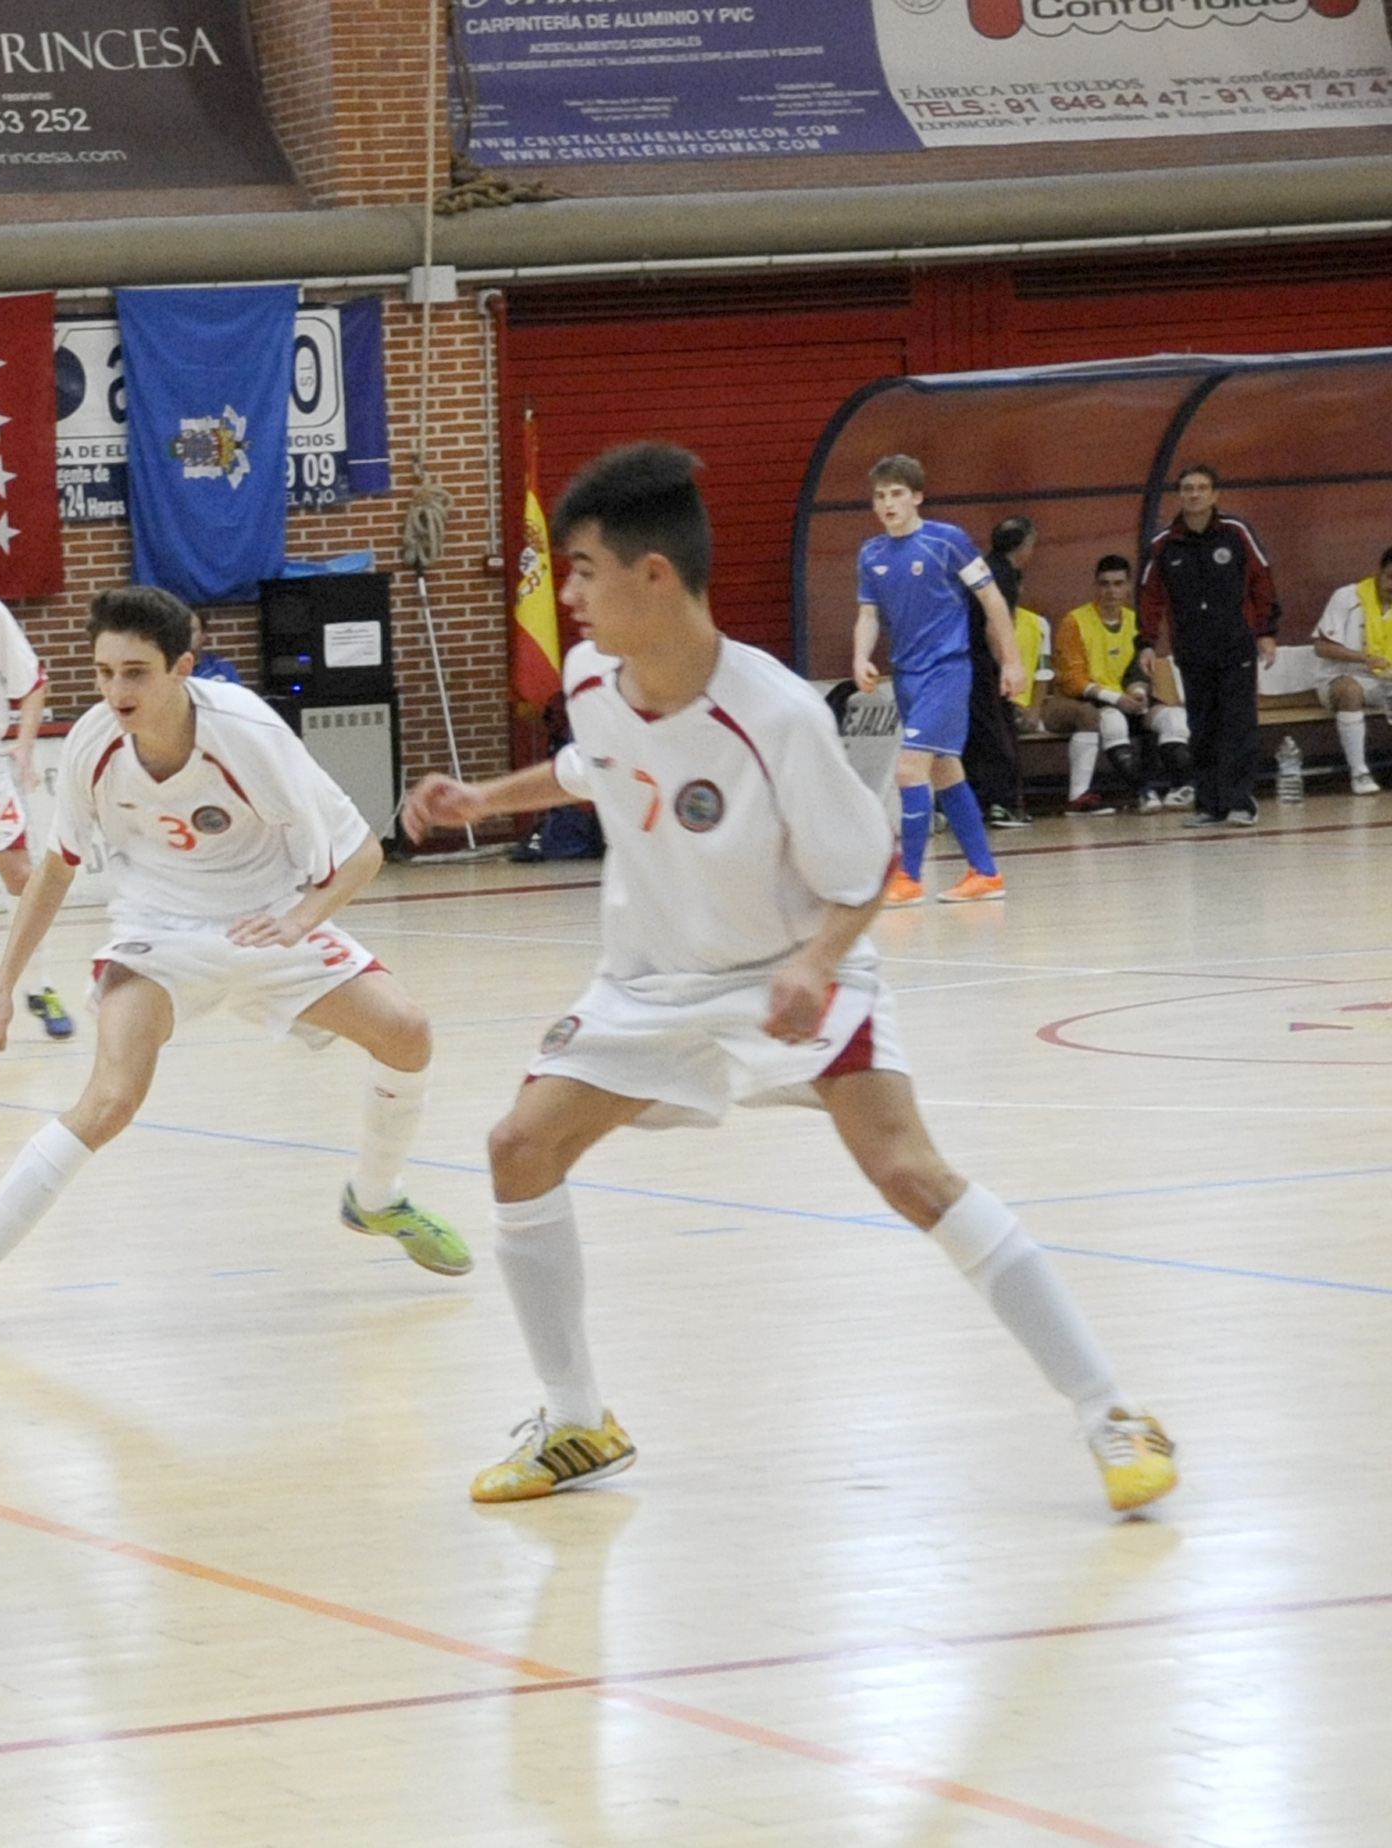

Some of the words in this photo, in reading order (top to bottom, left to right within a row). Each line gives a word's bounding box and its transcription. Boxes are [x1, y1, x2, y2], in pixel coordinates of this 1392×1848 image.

[465, 12, 583, 35] CARPINTERÍA
[586, 13, 610, 30] DE
[614, 9, 700, 28] ALUMINIO
[702, 9, 715, 24] Y
[719, 6, 755, 23] PVC
[899, 84, 1005, 100] FÁBRICA
[1010, 82, 1045, 97] DE
[1047, 78, 1145, 93] TOLDOS
[1005, 97, 1040, 114] 91
[1114, 92, 1149, 108] 44
[1158, 89, 1188, 106] 47
[1216, 87, 1252, 104] 91
[1262, 83, 1312, 101] 647
[1326, 81, 1357, 98] 47
[31, 107, 92, 133] 252
[78, 445, 101, 458] DE
[93, 464, 110, 483] de
[302, 452, 336, 488] 09
[65, 484, 85, 517] 24
[632, 767, 664, 833] 7
[159, 815, 197, 851] 3
